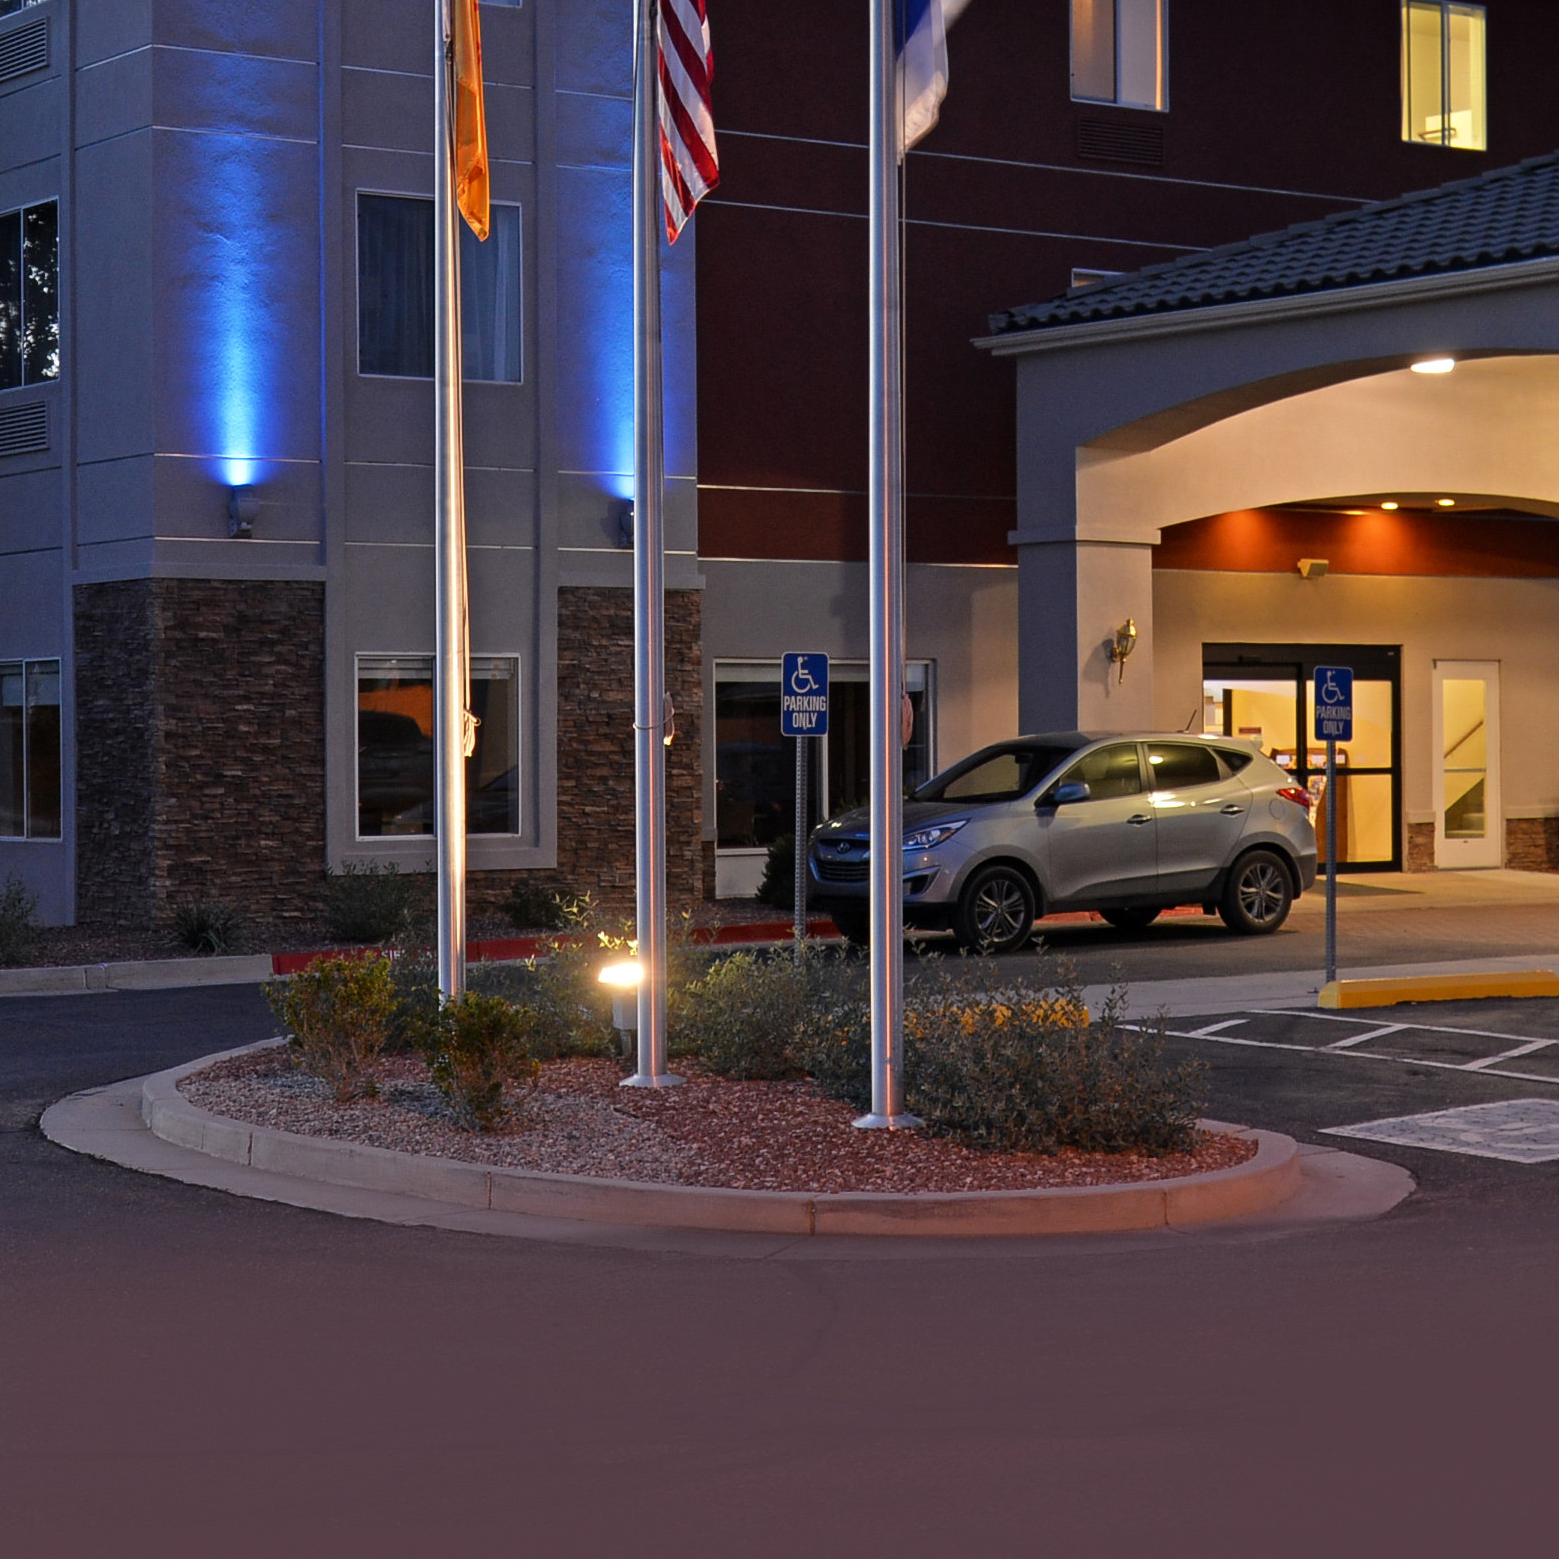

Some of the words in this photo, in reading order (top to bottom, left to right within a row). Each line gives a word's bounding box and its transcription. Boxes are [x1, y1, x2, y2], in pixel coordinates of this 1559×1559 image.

[783, 695, 827, 711] PARKING
[792, 712, 818, 728] ONLY
[1316, 705, 1352, 720] PARKING
[1323, 720, 1344, 735] ONLY
